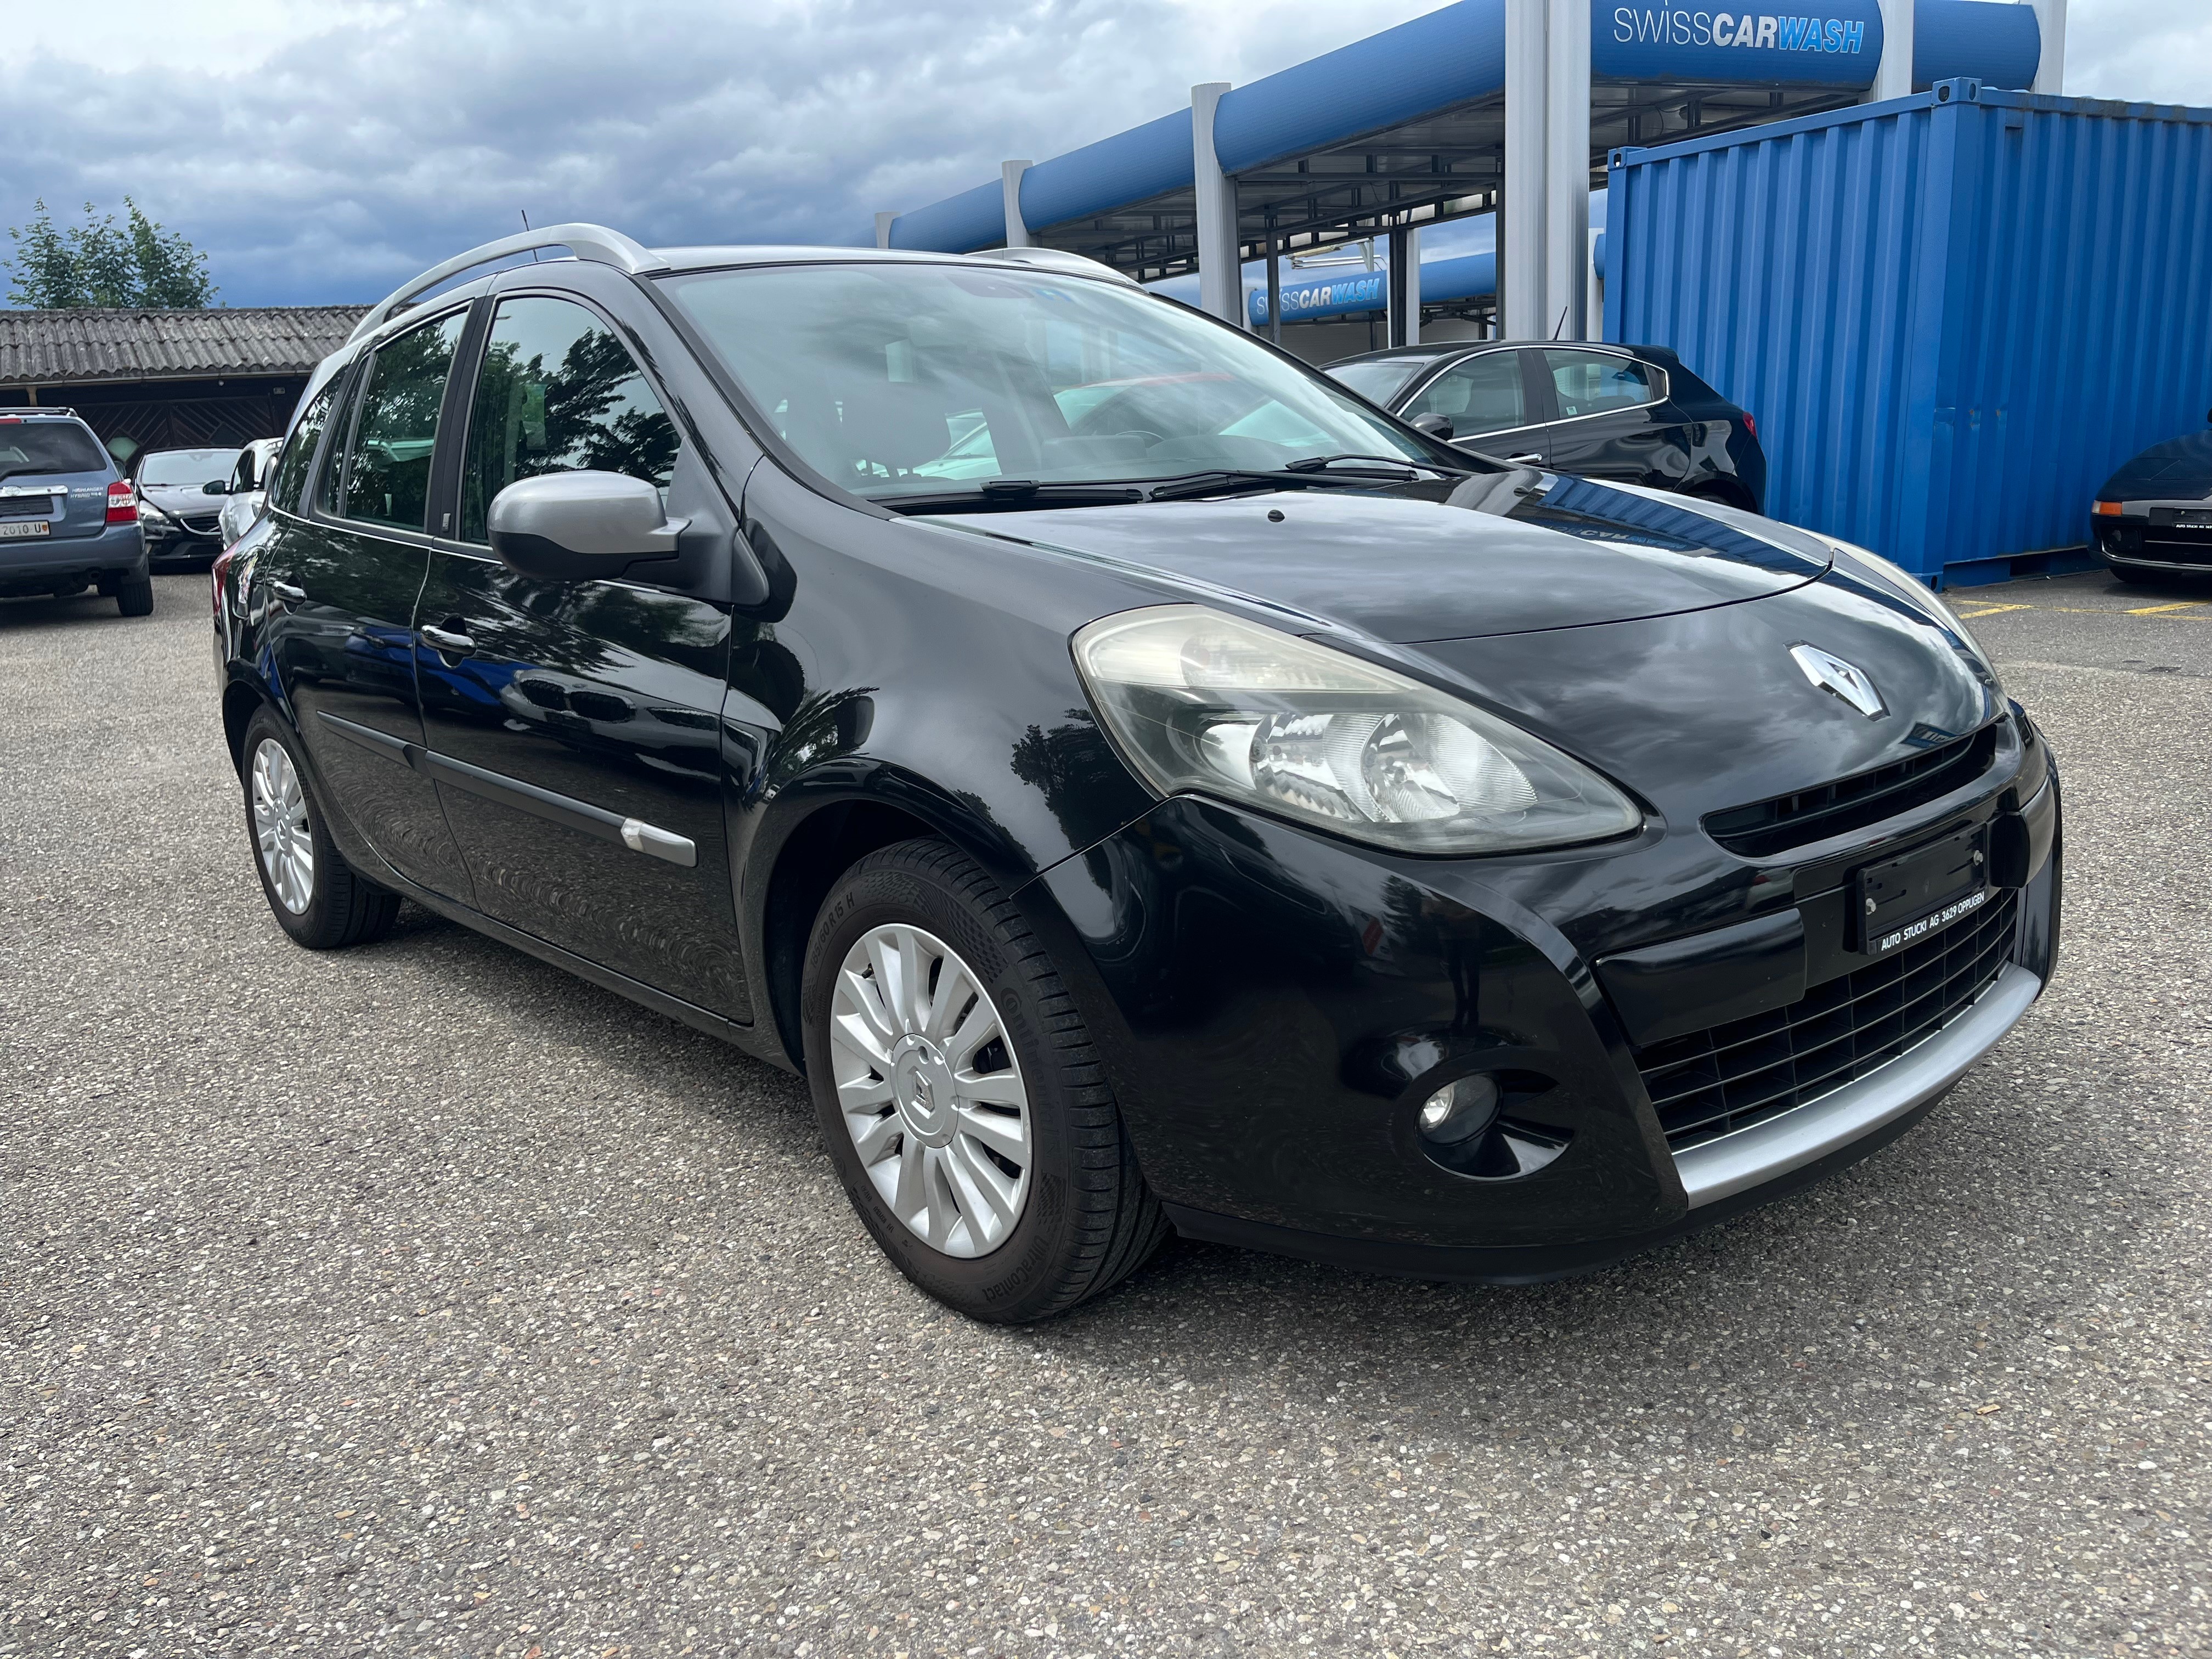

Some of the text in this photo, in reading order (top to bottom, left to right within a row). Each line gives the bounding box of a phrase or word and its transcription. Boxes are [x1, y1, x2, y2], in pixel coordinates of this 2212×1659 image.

[2, 523, 41, 535] 2010 U
[846, 891, 855, 910] H
[1881, 891, 1984, 951] AUTO STUCKI AG 3629 OPPLIGEN
